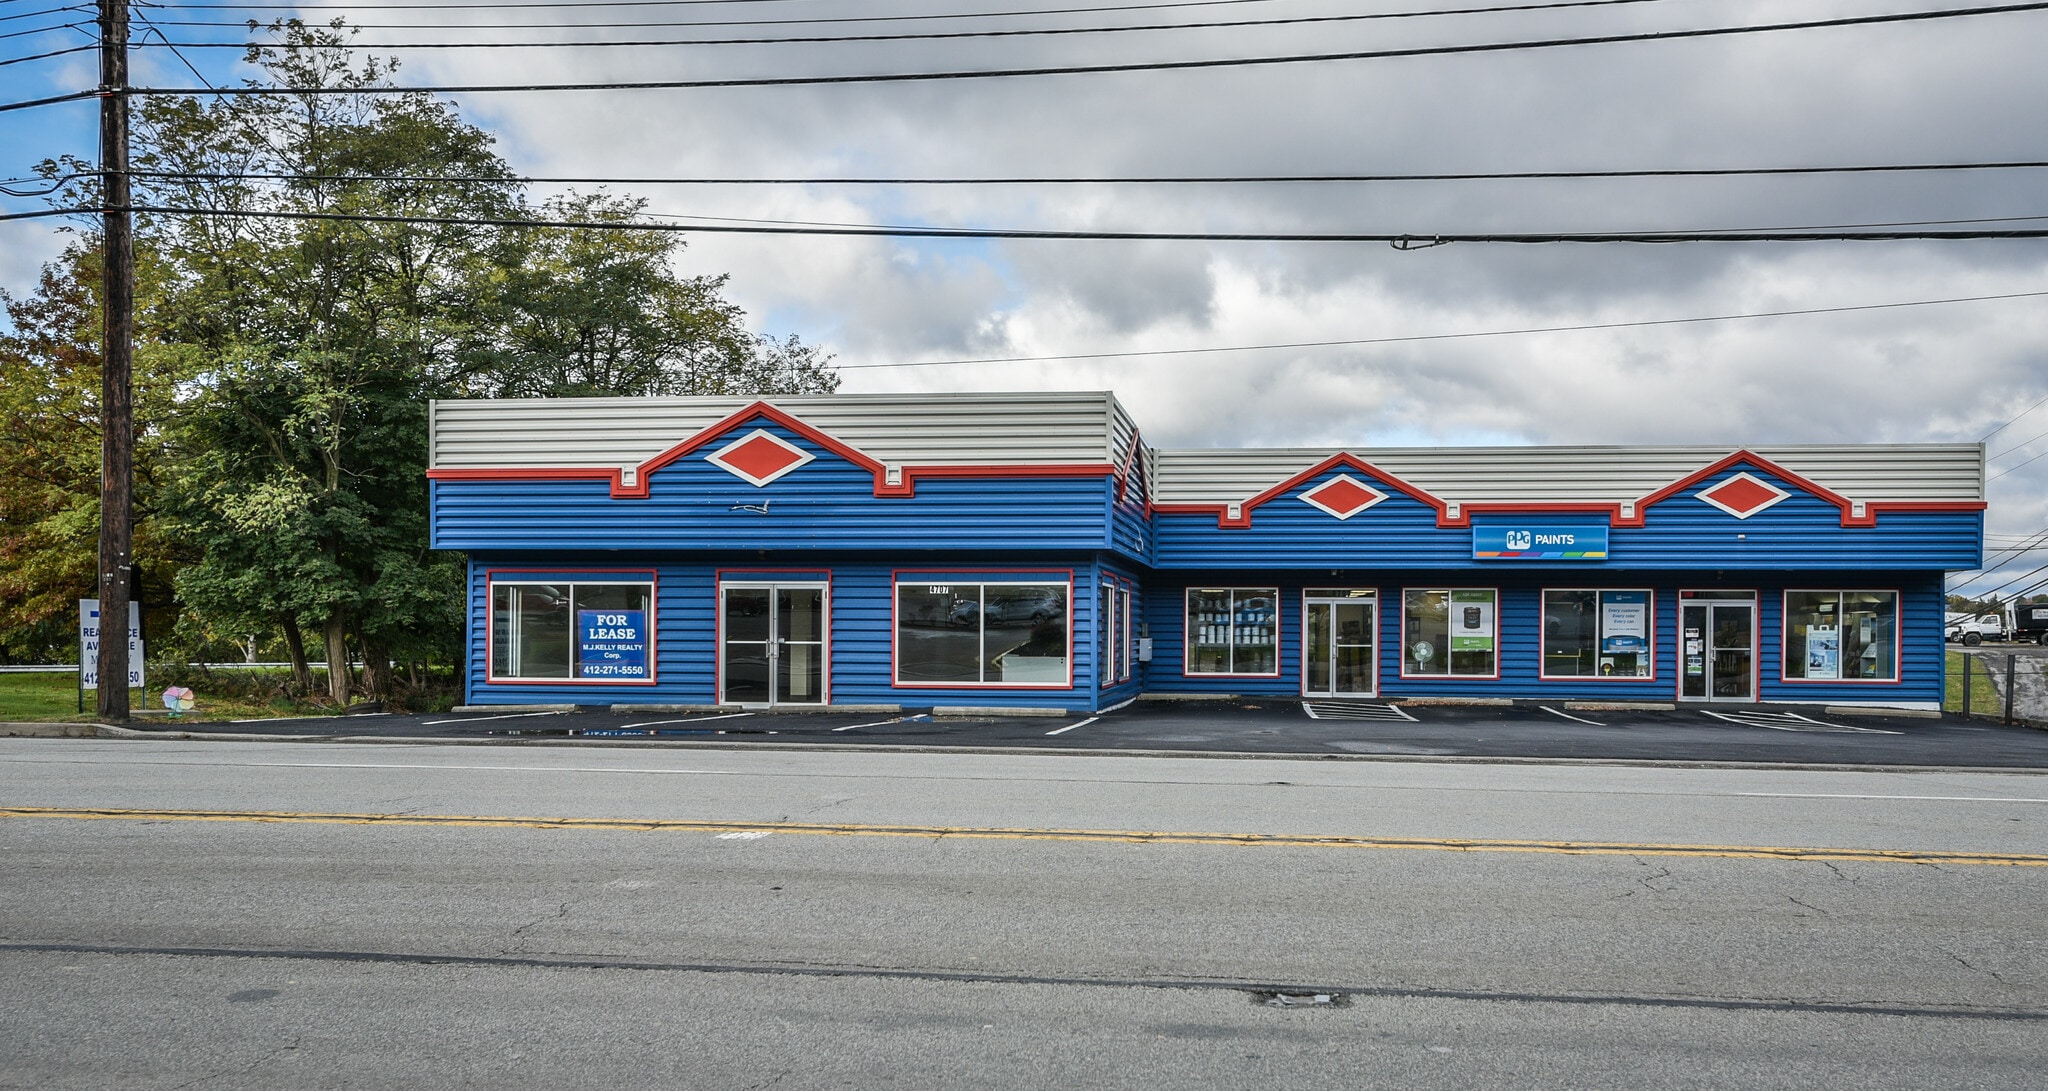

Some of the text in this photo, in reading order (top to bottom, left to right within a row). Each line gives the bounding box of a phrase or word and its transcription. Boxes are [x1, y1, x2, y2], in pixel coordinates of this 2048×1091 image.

[1507, 531, 1575, 547] PPG PAINTS
[930, 585, 948, 594] 4707
[597, 615, 627, 626] FOR
[589, 628, 636, 640] LEASE
[583, 665, 643, 675] 412-271-5550
